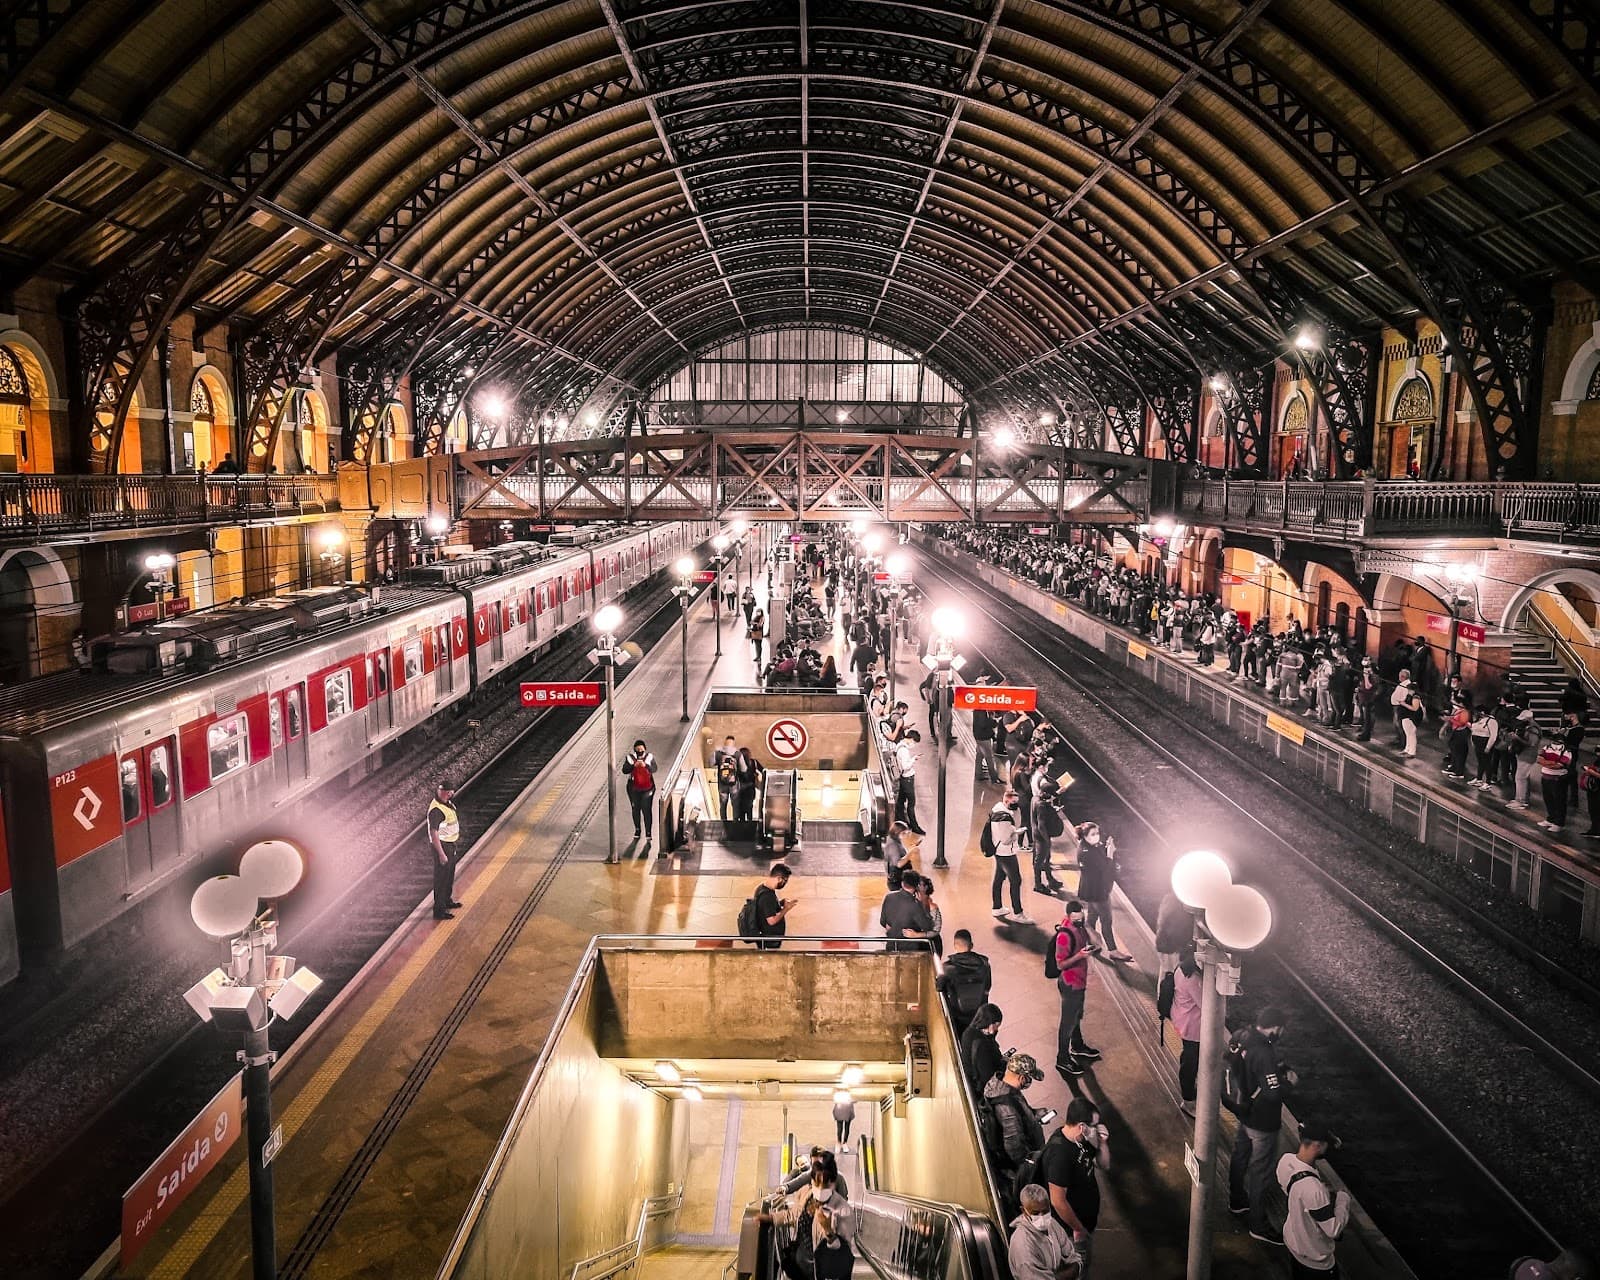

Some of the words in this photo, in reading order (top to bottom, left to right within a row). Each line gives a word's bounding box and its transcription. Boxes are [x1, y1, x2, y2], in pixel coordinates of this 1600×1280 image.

[549, 690, 584, 700] Saída
[978, 693, 1012, 704] Saída
[55, 770, 76, 788] P123
[135, 1207, 153, 1236] Exit
[156, 1136, 210, 1210] Saída
